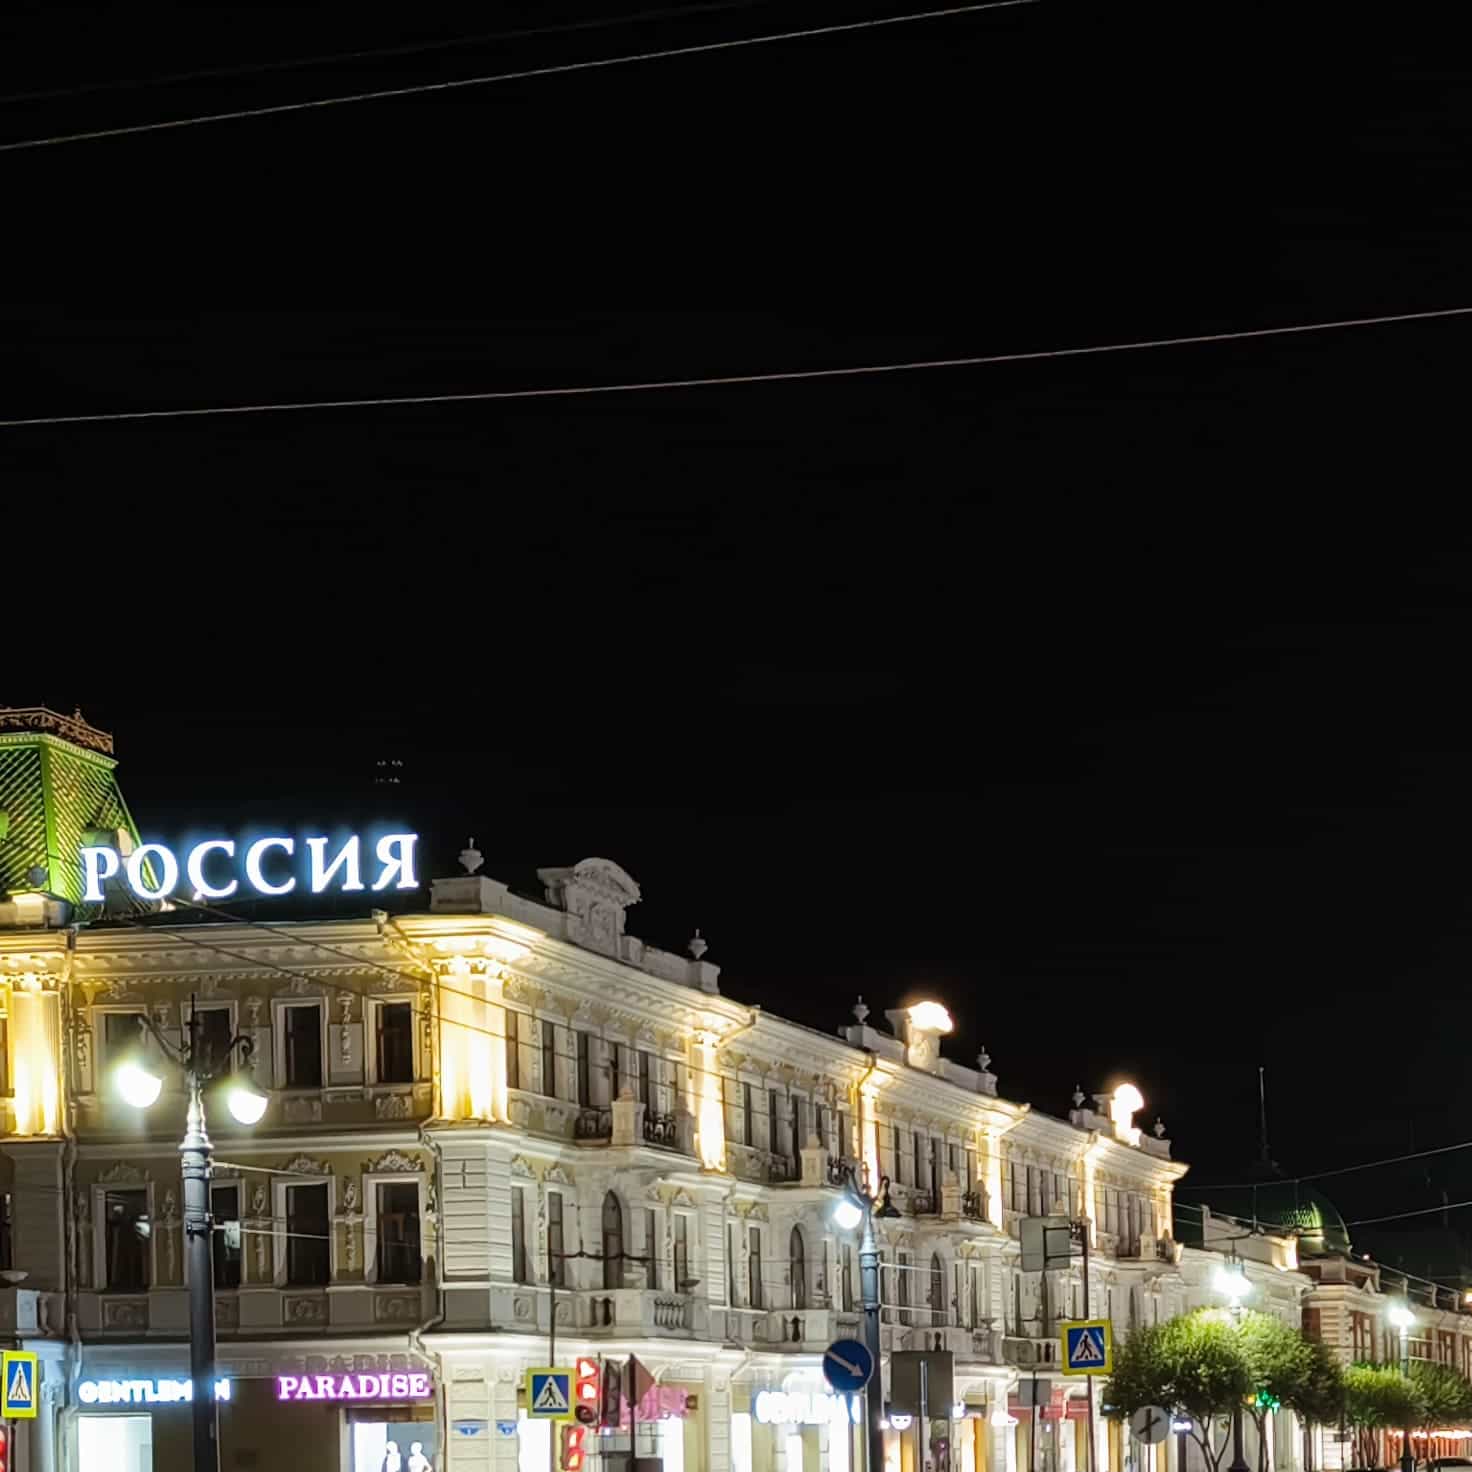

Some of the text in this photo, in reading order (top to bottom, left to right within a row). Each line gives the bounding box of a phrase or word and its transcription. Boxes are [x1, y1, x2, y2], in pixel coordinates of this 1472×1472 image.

[81, 833, 421, 902] РОССИЯ
[78, 1378, 231, 1403] GENTLEMN
[277, 1373, 431, 1401] PARADISE
